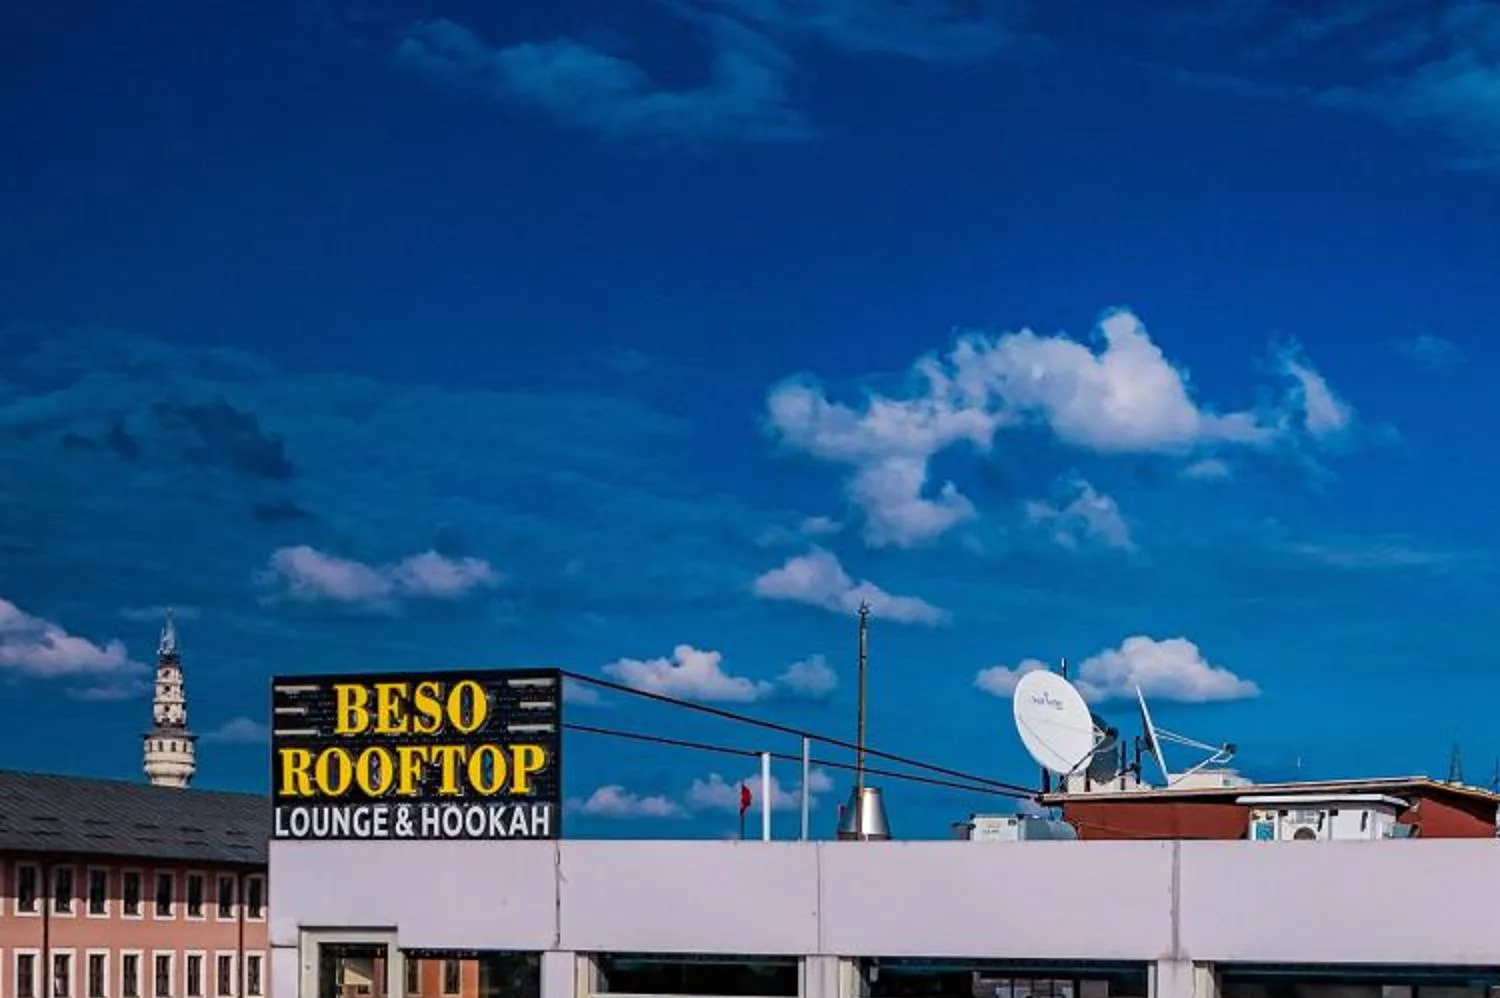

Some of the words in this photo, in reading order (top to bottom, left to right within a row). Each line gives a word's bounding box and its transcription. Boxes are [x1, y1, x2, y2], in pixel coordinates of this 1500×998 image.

[332, 680, 489, 735] BESO
[278, 744, 547, 797] ROOFTOP
[274, 804, 389, 838] LOUNGE
[394, 805, 416, 837] &
[421, 802, 551, 837] HOOKAH
